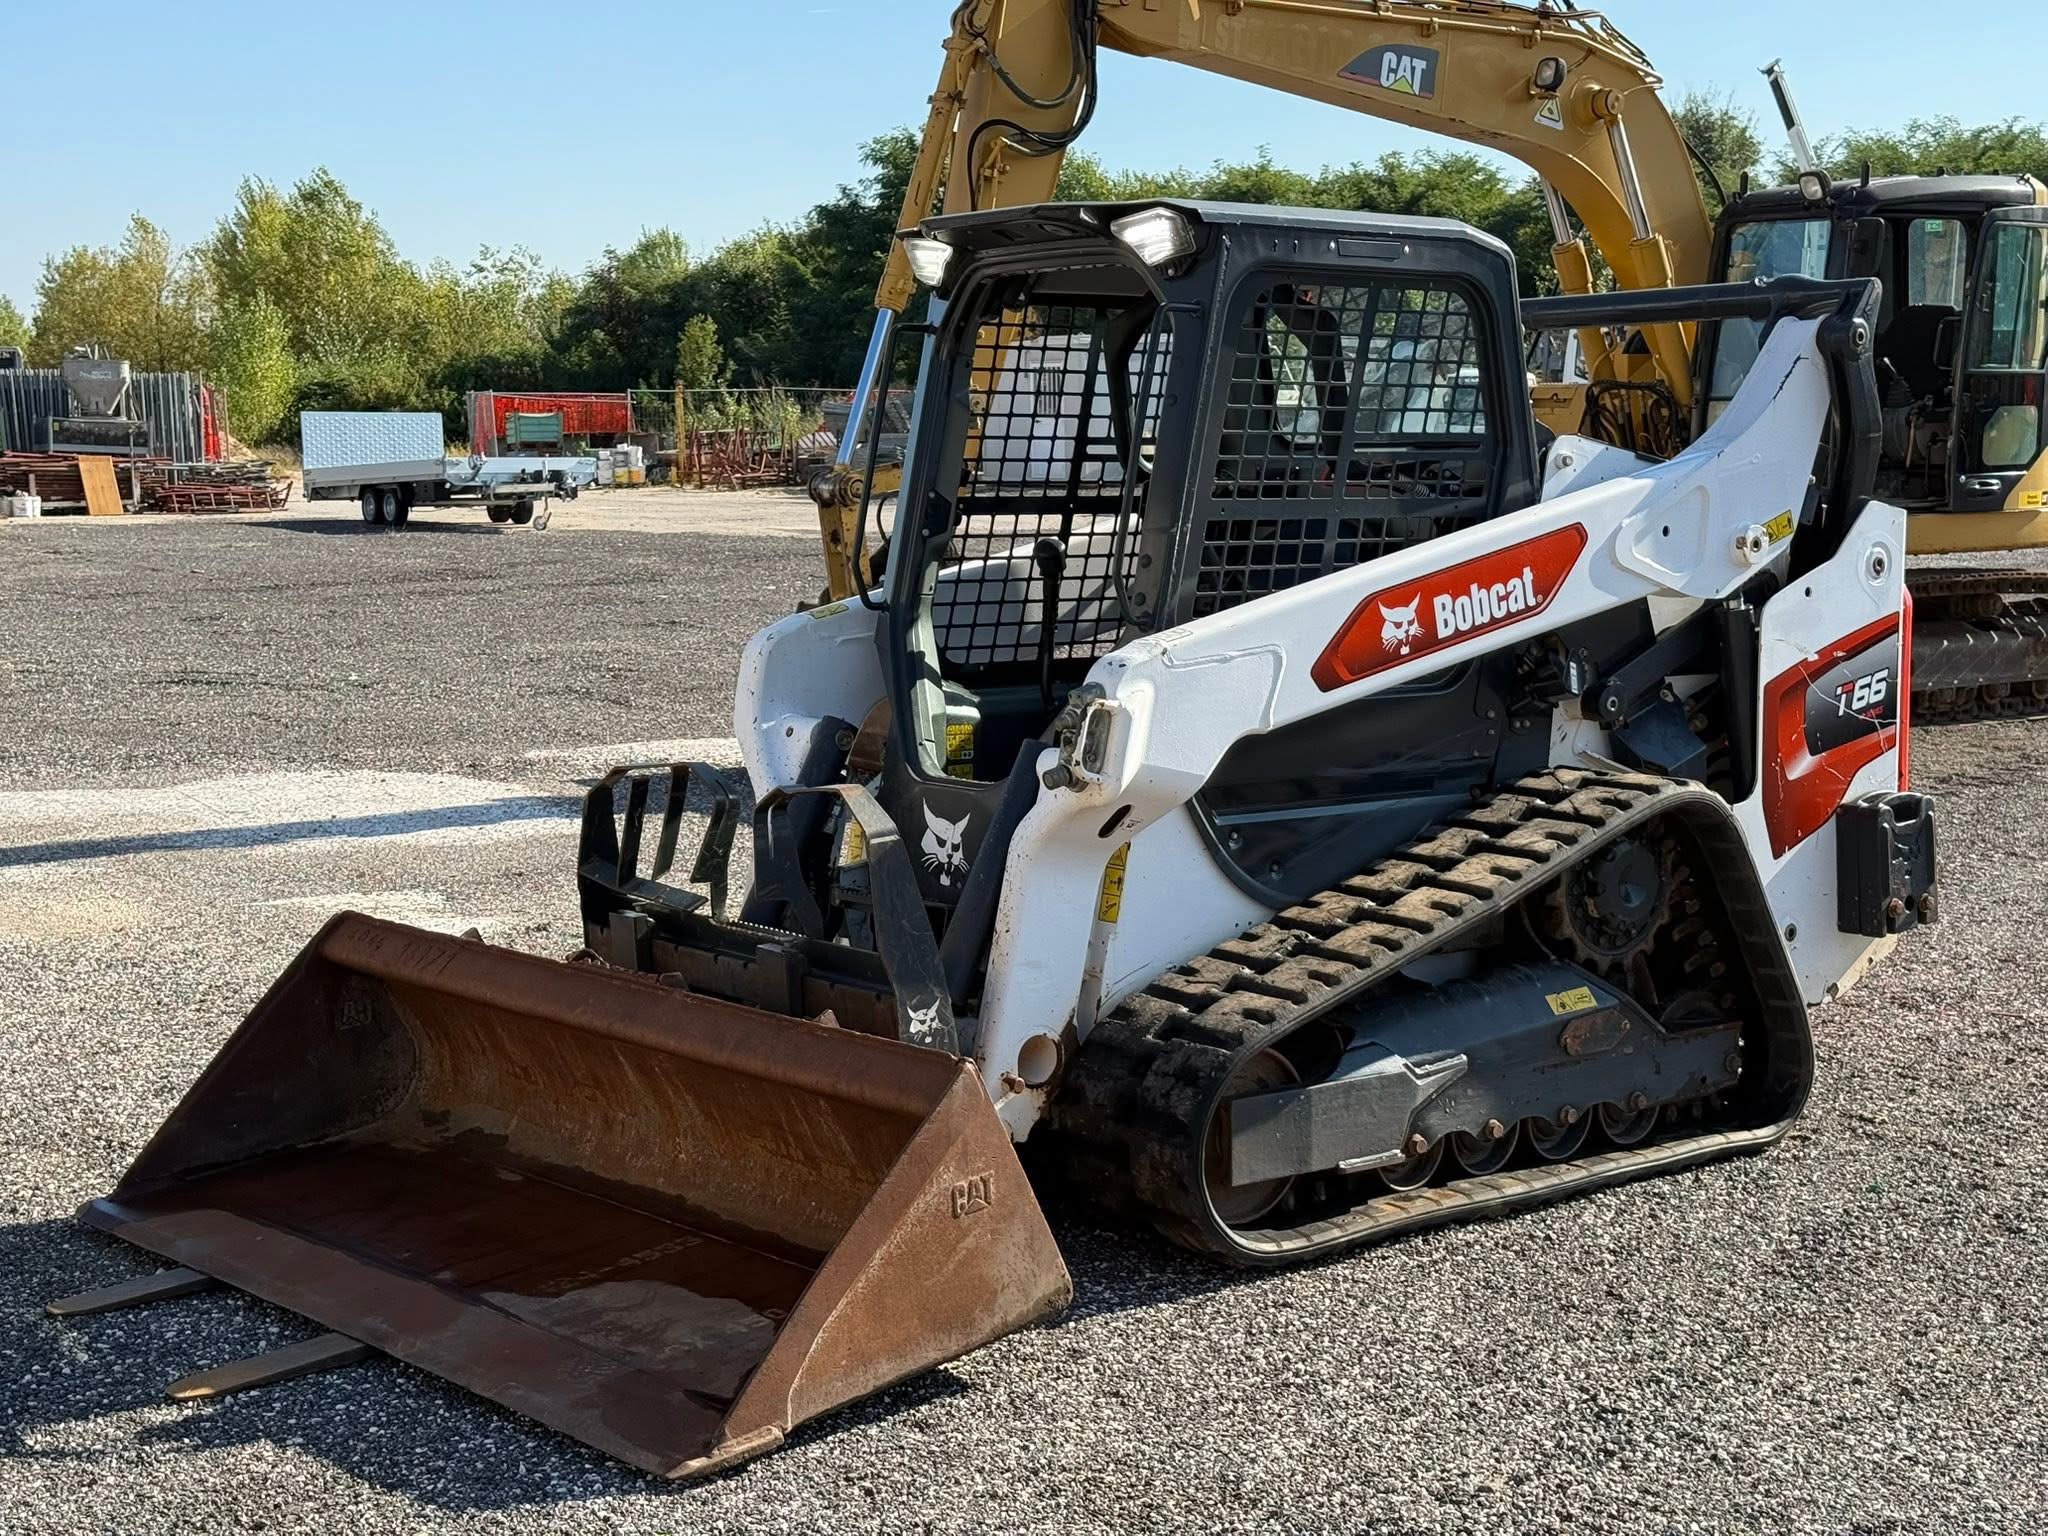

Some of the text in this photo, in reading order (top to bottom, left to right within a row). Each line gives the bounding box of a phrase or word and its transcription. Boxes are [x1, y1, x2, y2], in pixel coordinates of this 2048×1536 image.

[1380, 51, 1427, 96] CAT
[1433, 566, 1536, 639] Bobcat
[1835, 668, 1889, 717] T66
[951, 1170, 994, 1219] CAT
